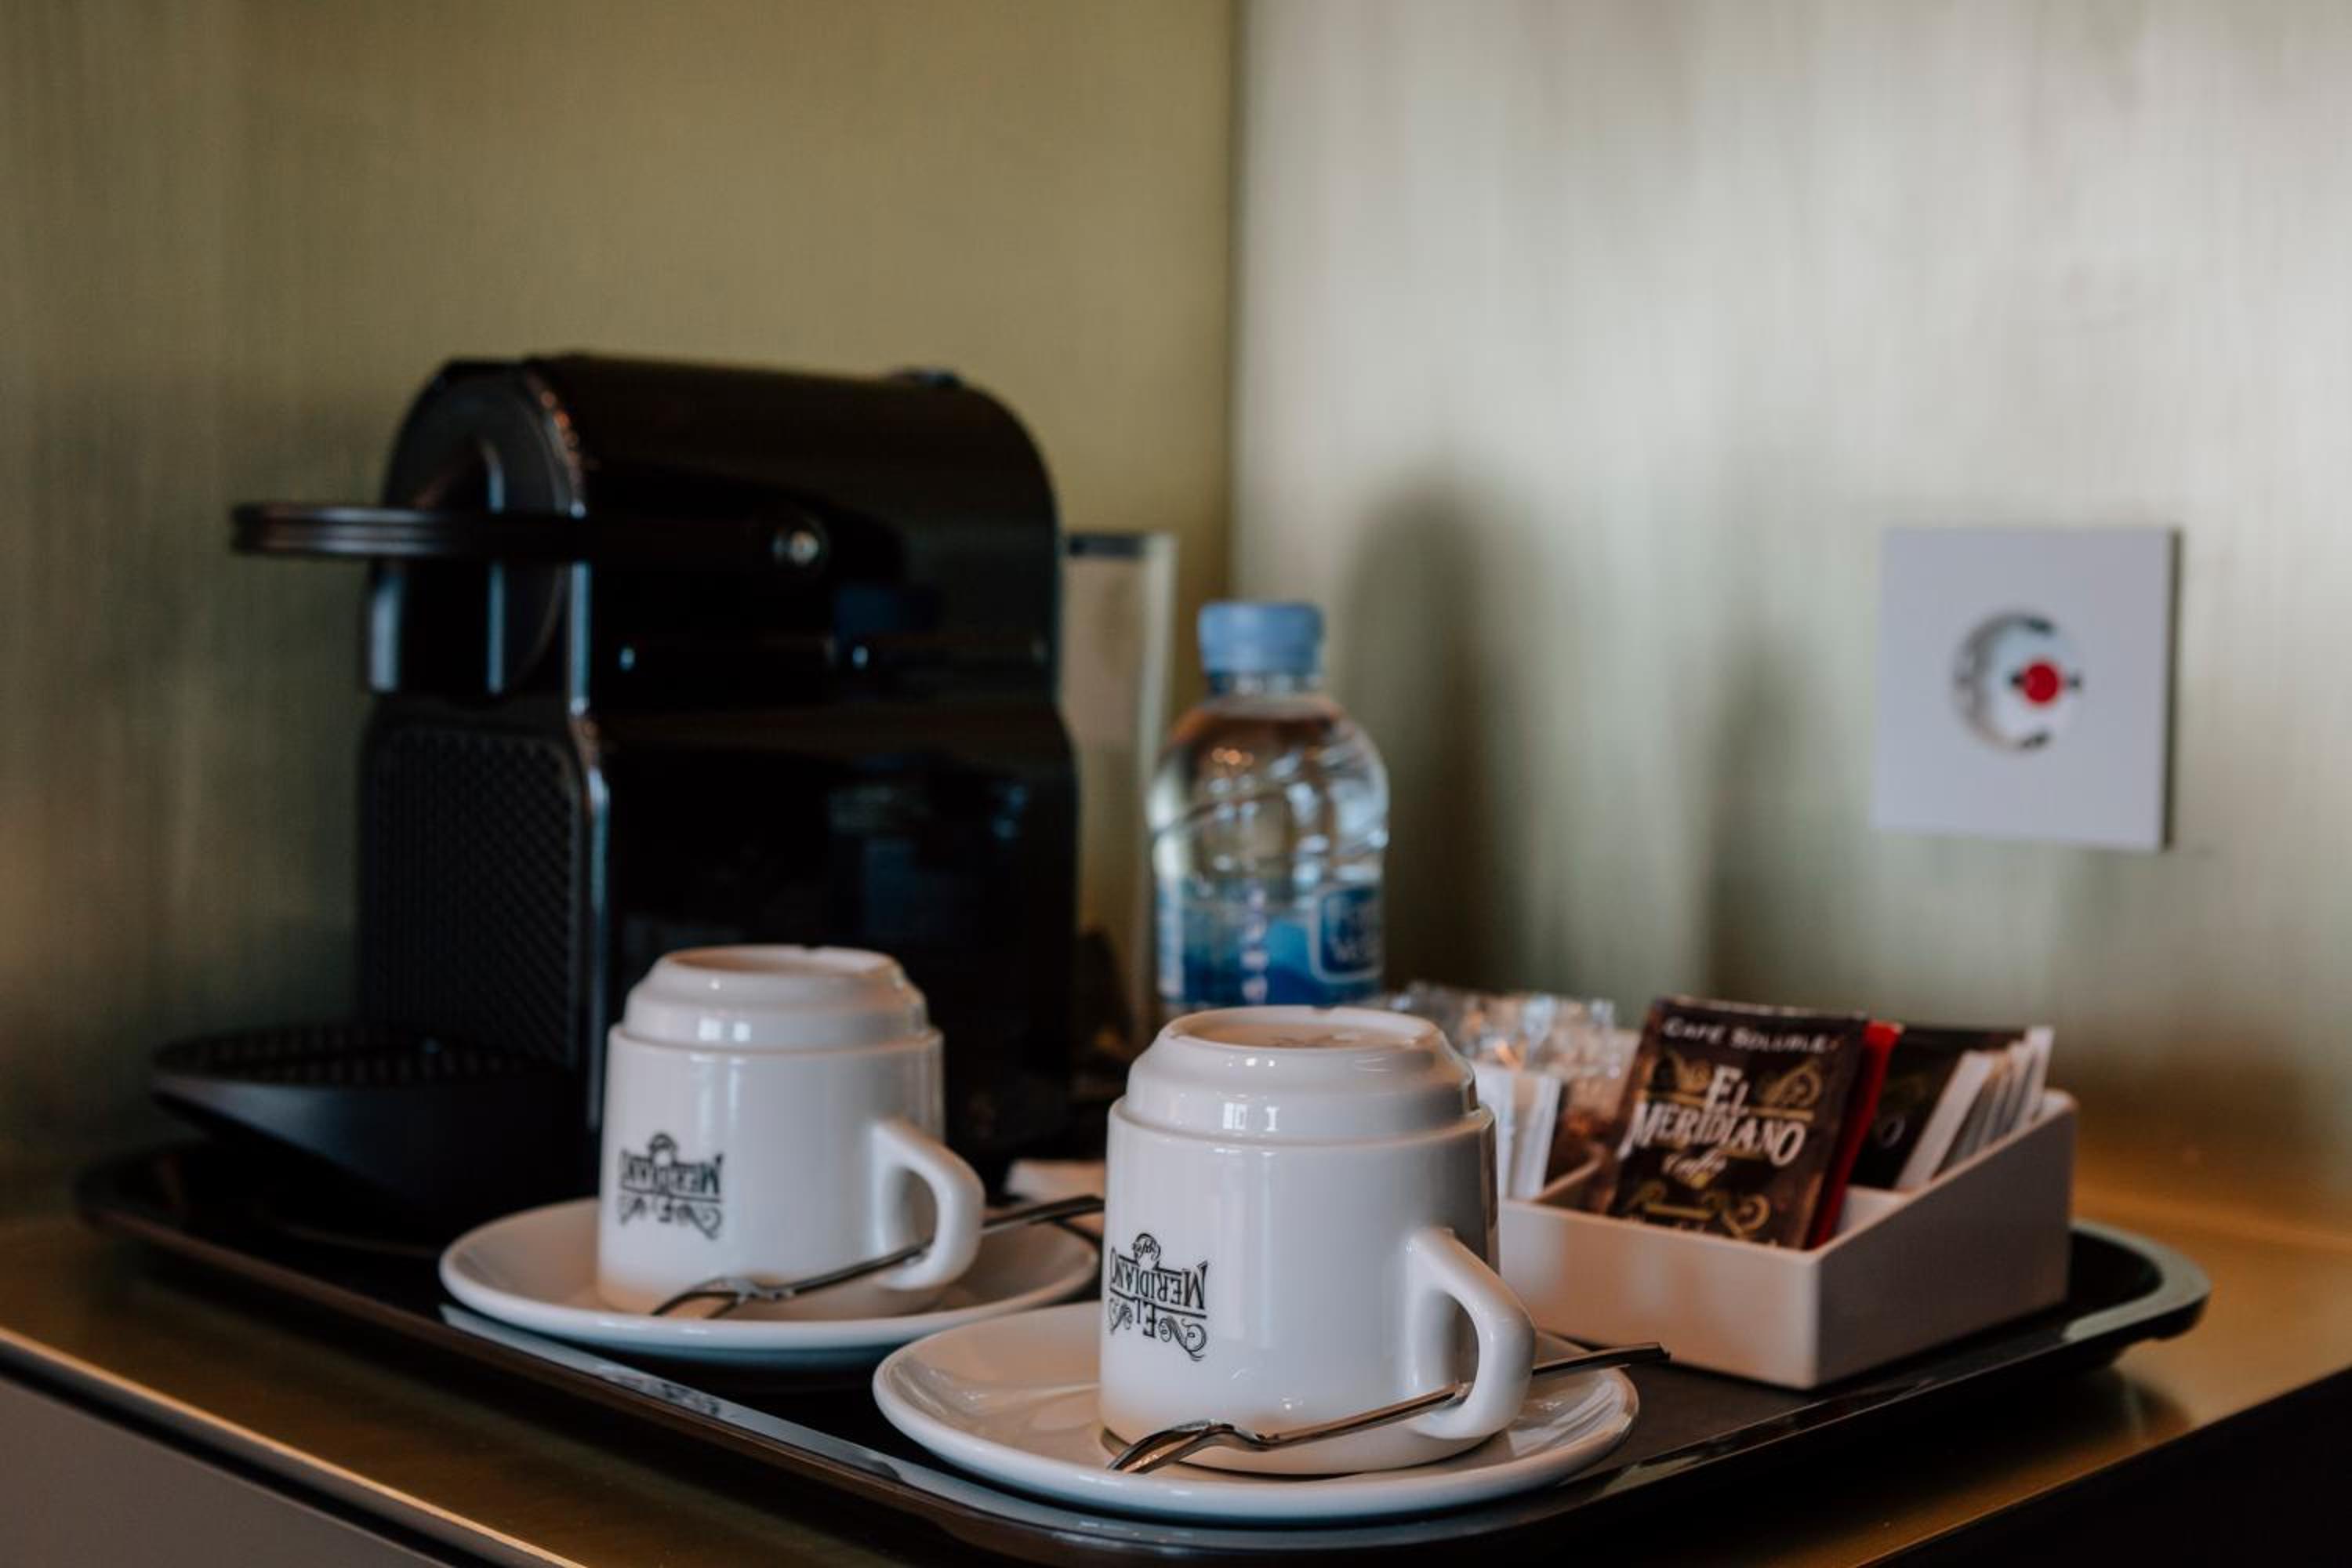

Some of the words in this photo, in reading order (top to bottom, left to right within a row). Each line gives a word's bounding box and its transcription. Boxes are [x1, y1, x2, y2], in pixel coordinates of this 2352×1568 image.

[1704, 1065, 1749, 1116] EL
[1616, 1103, 1806, 1166] MERIDIANO
[1110, 1247, 1207, 1309] MERIDIANO
[1134, 1297, 1156, 1338] EL
